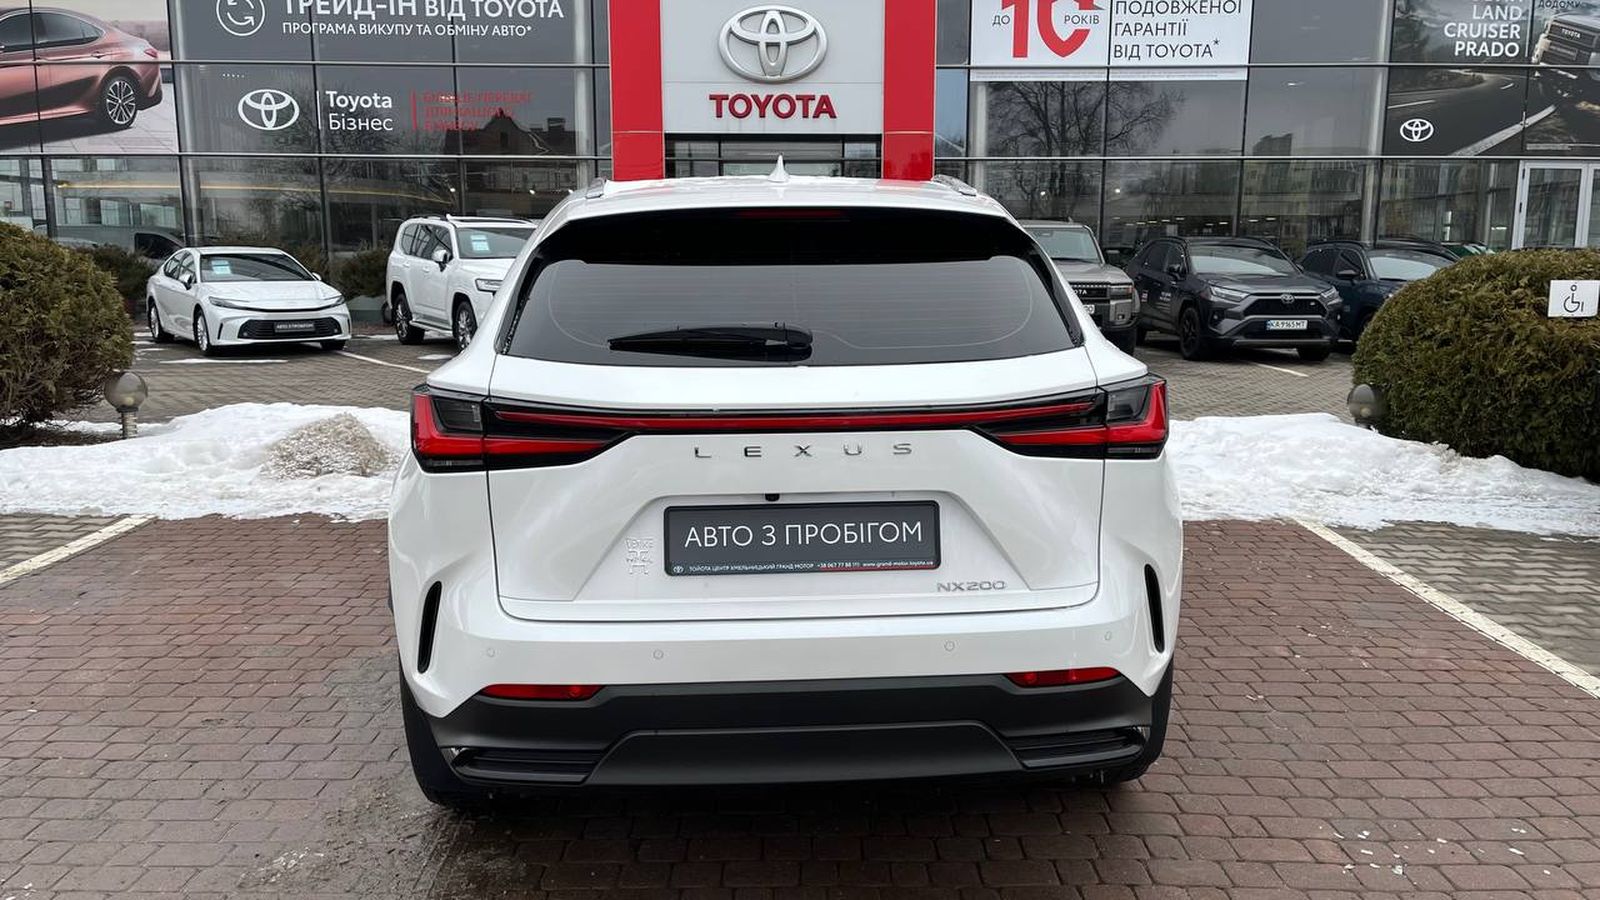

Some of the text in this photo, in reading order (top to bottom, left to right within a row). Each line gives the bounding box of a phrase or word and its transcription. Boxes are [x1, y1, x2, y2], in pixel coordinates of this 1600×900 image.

[425, 0, 466, 21] ВІД
[1472, 4, 1522, 20] LAND
[992, 14, 1010, 26] ДО
[1064, 15, 1100, 25] РОКІВ
[1114, 18, 1188, 36] ГАРАНТІЇ
[282, 22, 356, 34] ПРОГРАМА
[359, 23, 413, 35] ВИКУПУ
[416, 24, 432, 35] ТА
[434, 24, 489, 36] ОБМІНУ
[1444, 22, 1521, 39] CRUISER
[1113, 44, 1141, 60] ВІД
[1454, 41, 1520, 57] PRADO
[325, 90, 393, 112] Toyota
[709, 93, 837, 119] TOYOTA
[328, 112, 394, 131] Бізнес
[694, 443, 913, 459] LEXUS
[684, 521, 922, 548] АВТО З ПРОБІГОМ
[937, 580, 1006, 593] NX200
